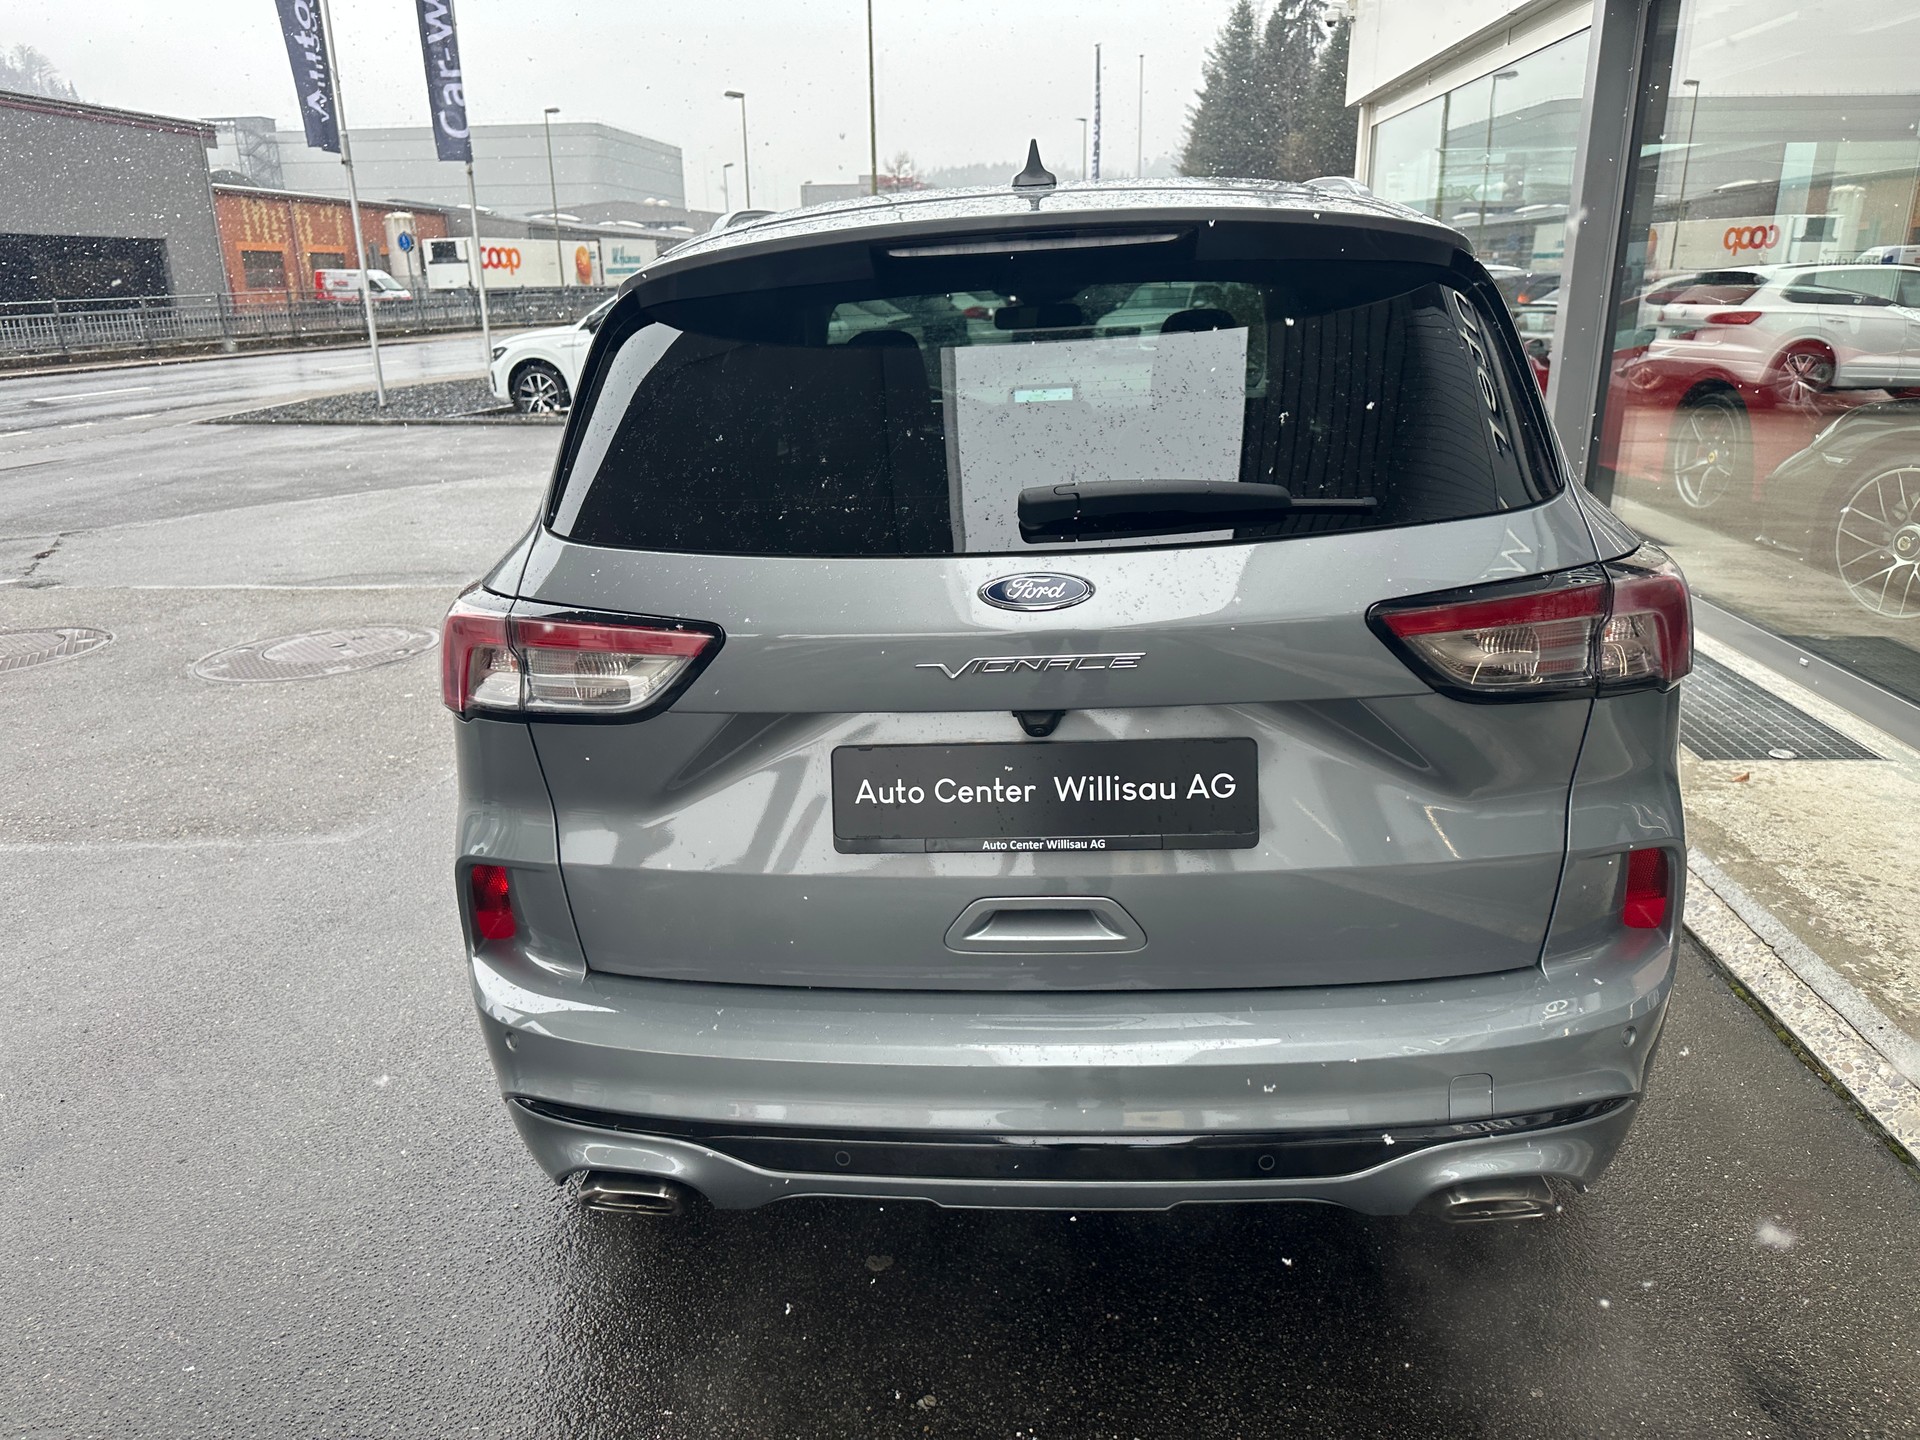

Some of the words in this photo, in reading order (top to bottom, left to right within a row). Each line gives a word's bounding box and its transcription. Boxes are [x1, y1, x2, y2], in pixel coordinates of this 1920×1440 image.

[1006, 577, 1066, 600] Ford
[915, 652, 1147, 679] VIGNALE
[855, 778, 925, 804] Auto
[934, 777, 1037, 803] Center
[1053, 775, 1176, 802] Willisau
[1186, 773, 1237, 799] AG
[982, 840, 1008, 850] Auto
[1009, 840, 1045, 850] Center
[1046, 839, 1088, 849] Willisau
[1090, 839, 1106, 849] AG
